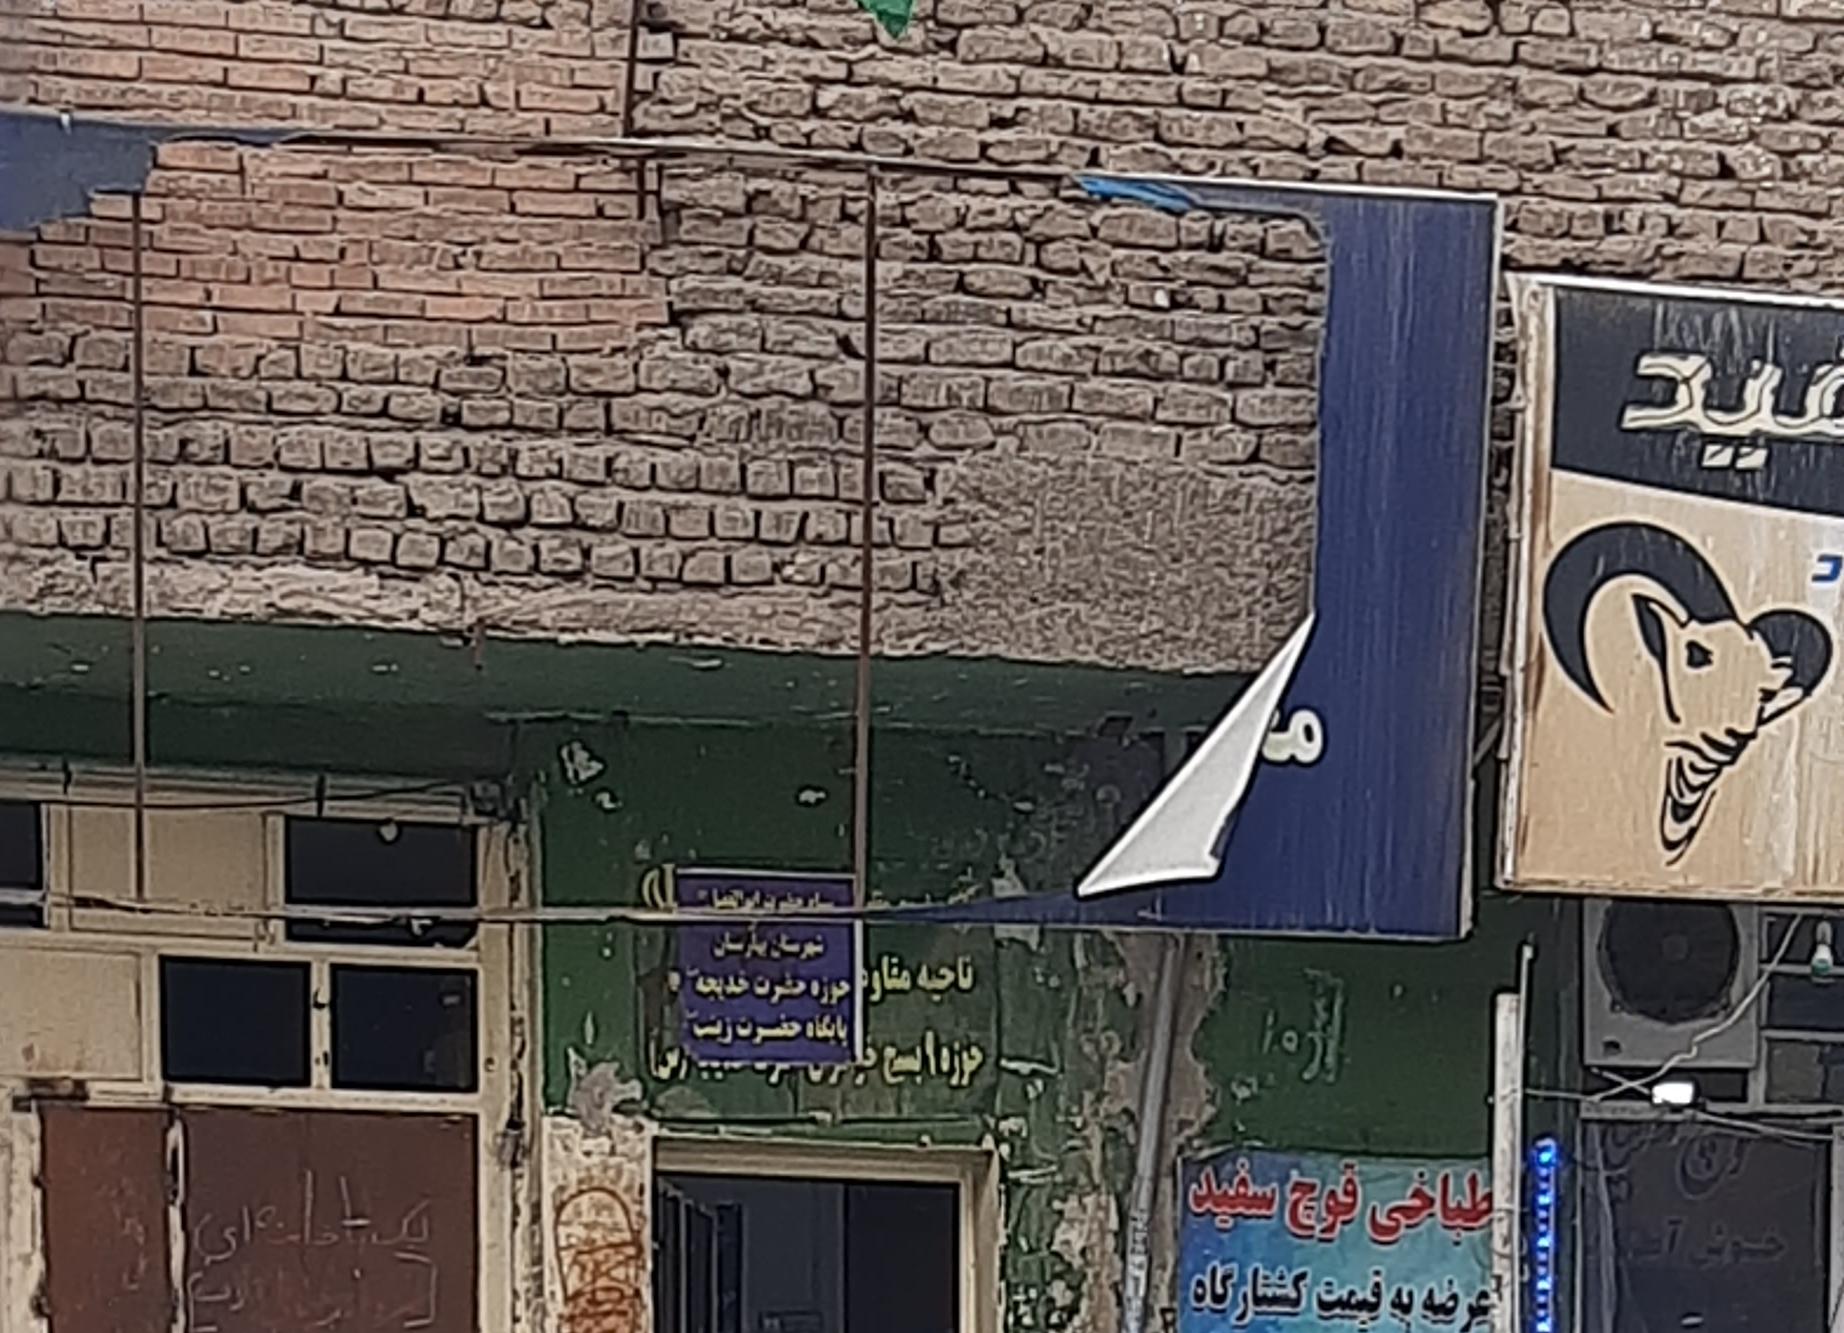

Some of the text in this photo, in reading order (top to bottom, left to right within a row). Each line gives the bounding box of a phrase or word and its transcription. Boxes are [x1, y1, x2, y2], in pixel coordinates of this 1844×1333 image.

[1620, 350, 1844, 471] فید
[754, 972, 807, 1004] حضرت
[810, 975, 851, 1004] حوزه
[735, 1012, 802, 1045] حضرت
[1189, 1159, 1494, 1244] طباخی قوچ سفید
[1317, 1269, 1383, 1332] قیمت
[1391, 1285, 1415, 1333] به
